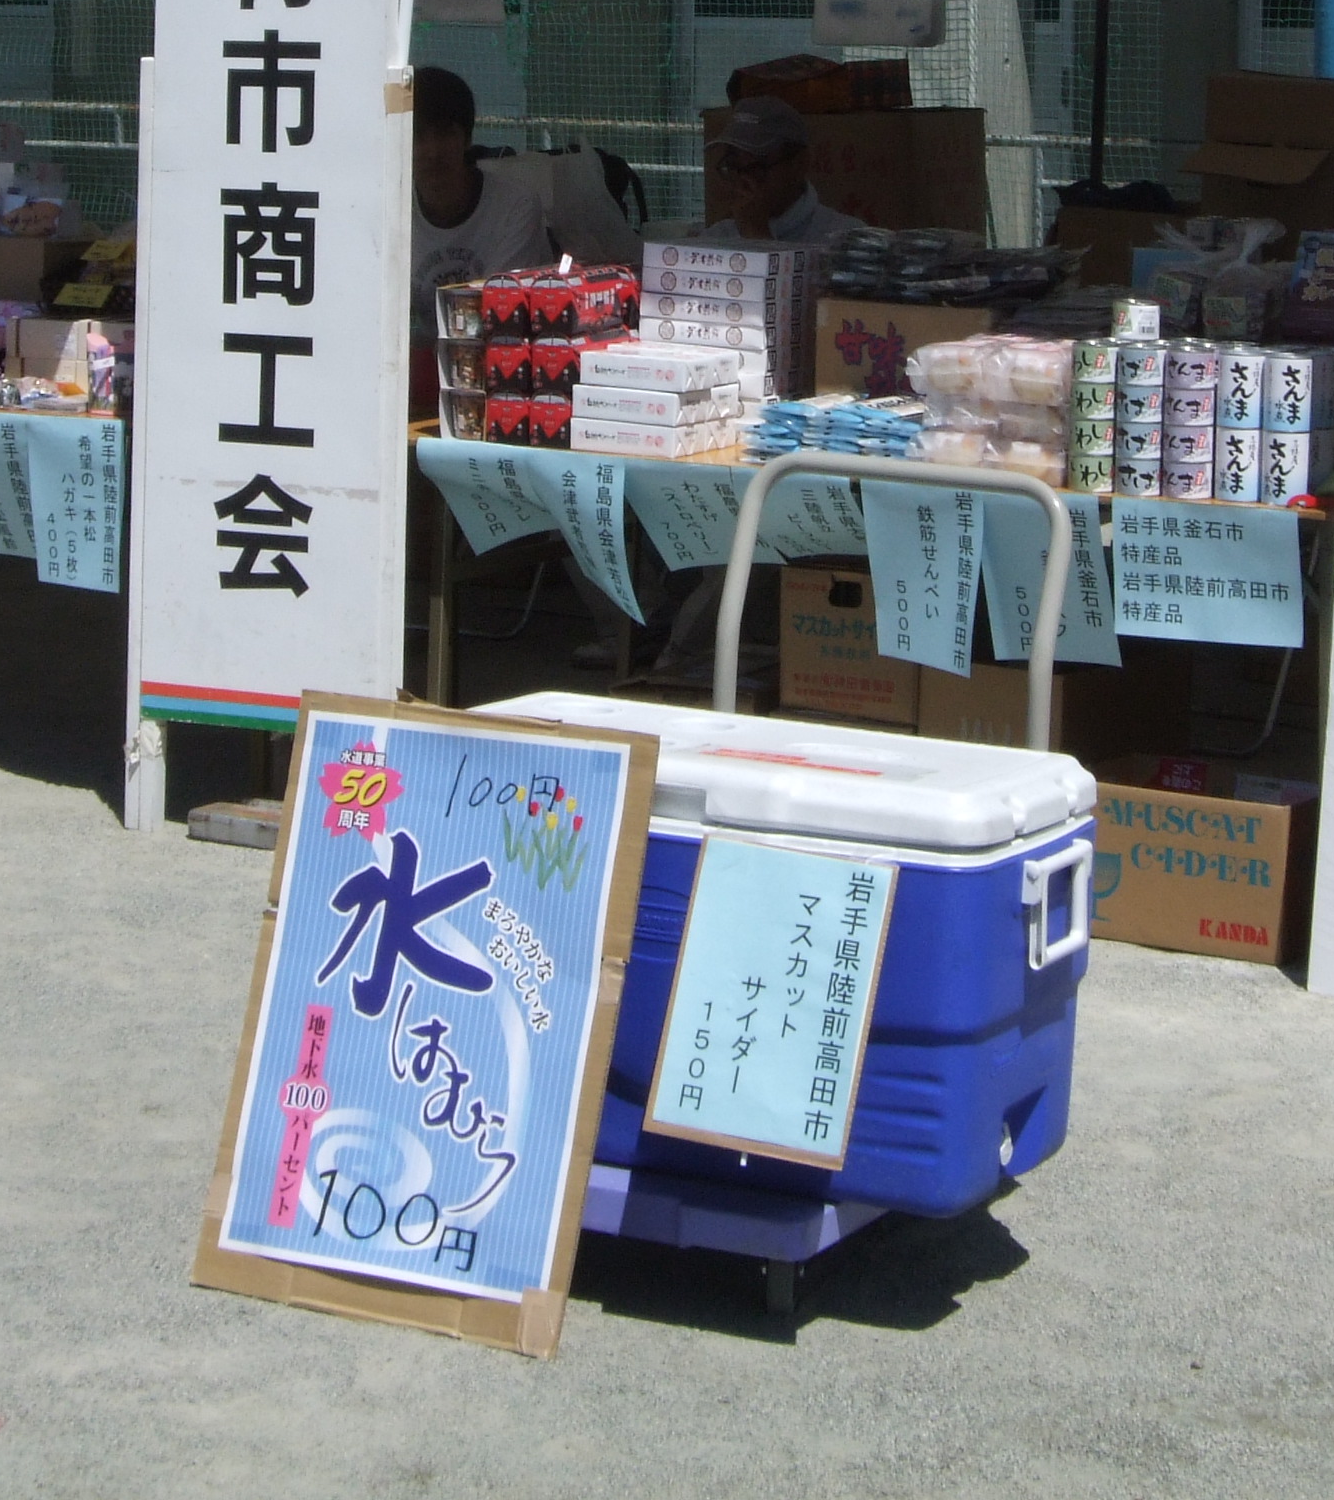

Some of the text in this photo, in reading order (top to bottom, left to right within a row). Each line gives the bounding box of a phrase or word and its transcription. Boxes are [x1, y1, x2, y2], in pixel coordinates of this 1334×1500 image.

[1230, 361, 1257, 422] さんま
[1282, 364, 1310, 426] さんま
[78, 435, 97, 543] 希望の一本松
[1225, 435, 1253, 495] さんま
[1269, 438, 1296, 499] さんま
[101, 424, 118, 585] 岩手県陸前高田市
[1120, 513, 1244, 543] 岩手県釜石市
[47, 513, 60, 578] 400円
[917, 505, 939, 619] 鉄筋せんべい
[1070, 508, 1103, 629] 岩手県釜石市
[1120, 543, 1183, 567] 特産品
[953, 491, 974, 669] 岩手県陸前高田市
[1122, 570, 1291, 603] 岩手県陸前高田市
[896, 579, 911, 652] 500円
[1122, 601, 1184, 626] 特産品
[333, 769, 387, 808] 50
[340, 749, 387, 768] 水道事業
[444, 753, 562, 818] 100円
[337, 809, 371, 831] 周年
[482, 899, 556, 984] まろやかな
[1199, 917, 1271, 947] KANDA
[487, 936, 551, 1034] おいしい水
[780, 891, 822, 1040] マスカット
[730, 975, 767, 1095] サイダー
[803, 871, 876, 1142] 岩手県陸前高田市
[678, 1001, 715, 1112] 150円
[313, 1168, 478, 1273] 100円
